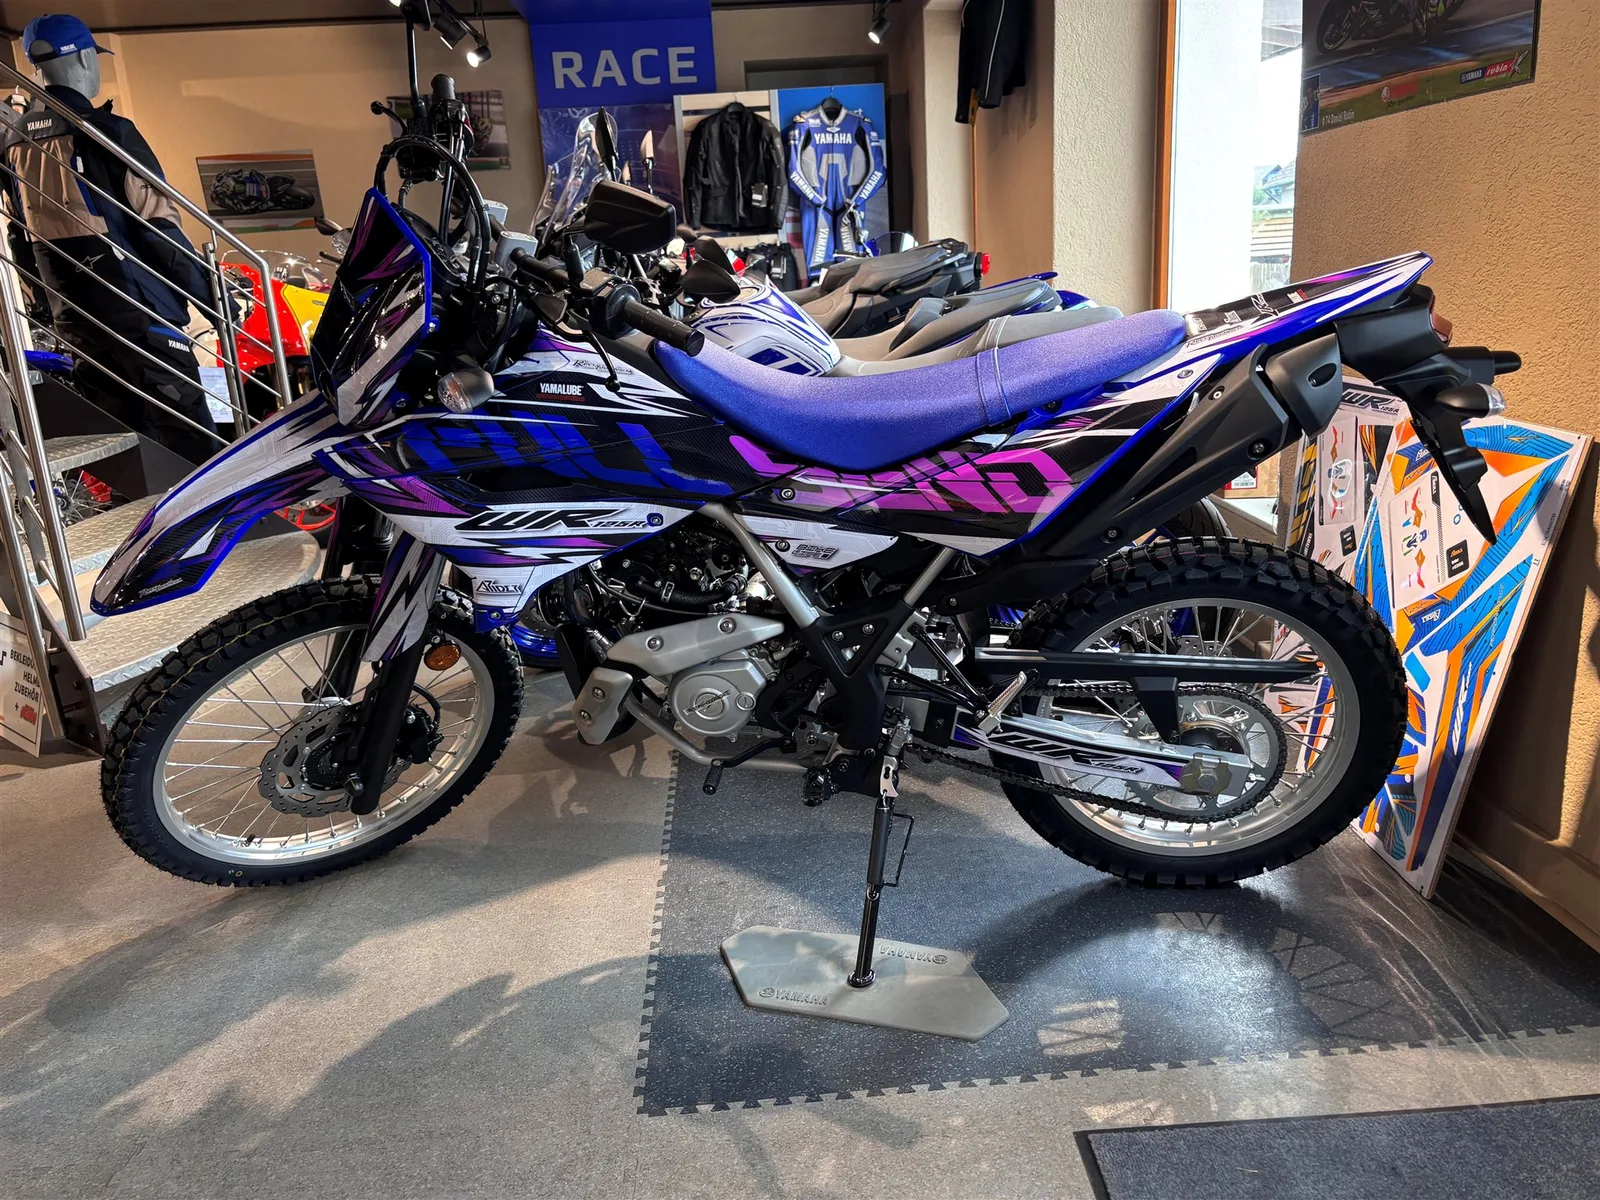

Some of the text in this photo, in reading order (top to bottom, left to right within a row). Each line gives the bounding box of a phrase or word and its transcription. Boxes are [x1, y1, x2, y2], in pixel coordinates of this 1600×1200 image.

[552, 46, 698, 89] RACE
[1486, 63, 1508, 76] rubin
[27, 119, 52, 131] YAMAHA
[814, 133, 852, 144] YAMAHA
[790, 171, 815, 200] YAMAHA
[860, 171, 882, 199] YAMAHA
[814, 228, 829, 262] YAMAHA
[168, 340, 190, 352] YAMAHA
[540, 382, 583, 396] YAMALUBE
[589, 520, 648, 529] 125R
[15, 682, 39, 703] ZUBEHÖR
[880, 944, 931, 963] YAMAHA
[775, 989, 829, 1005] YAMAHA
